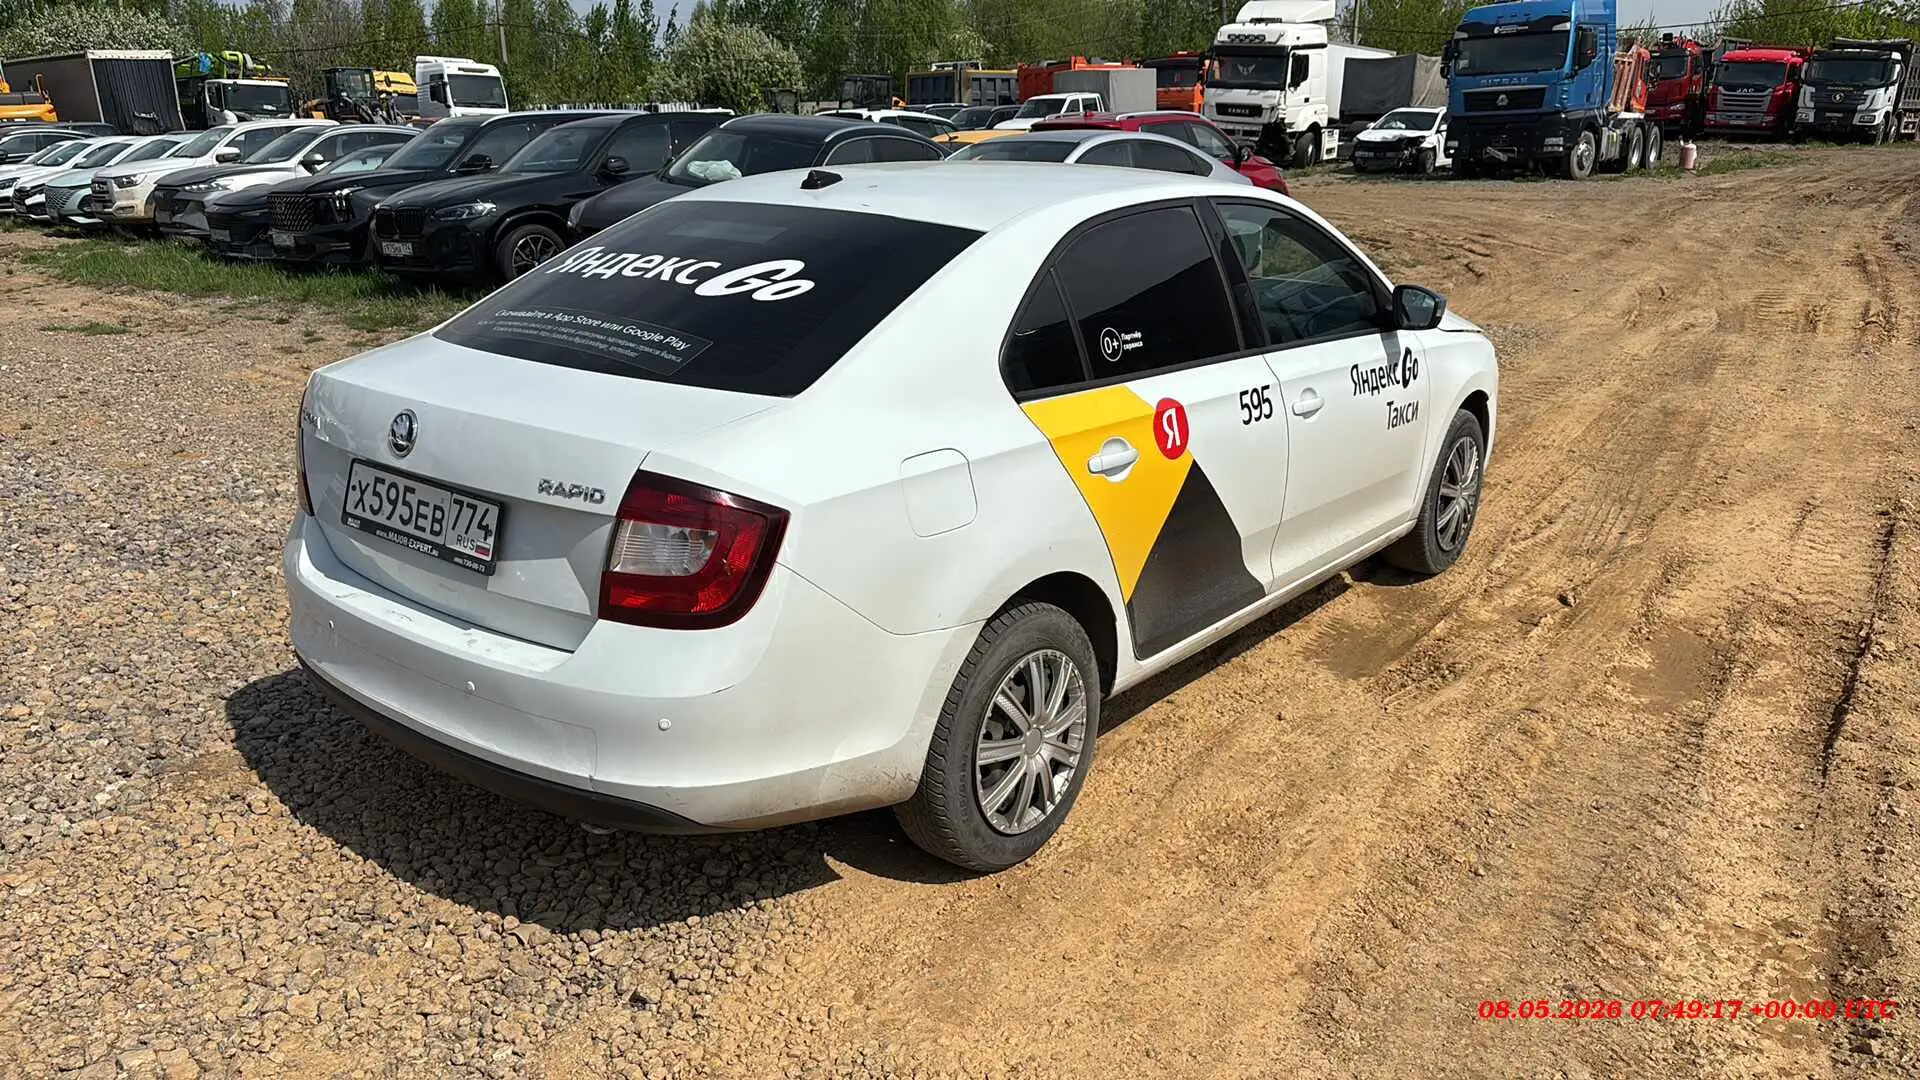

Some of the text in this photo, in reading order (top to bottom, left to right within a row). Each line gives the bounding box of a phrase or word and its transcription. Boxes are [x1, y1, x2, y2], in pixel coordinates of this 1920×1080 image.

[546, 247, 815, 301] Яндекс Go
[551, 312, 575, 322] App
[572, 316, 602, 327] Store
[600, 322, 624, 331] или
[623, 325, 664, 342] Google
[662, 336, 691, 350] Play
[1104, 337, 1120, 354] 0+
[1350, 346, 1419, 397] Яндекс Go
[1240, 385, 1273, 425] 595
[1386, 400, 1419, 430] Такси
[1162, 408, 1181, 449] Я
[538, 478, 606, 504] RAPID
[456, 534, 475, 551] RUS
